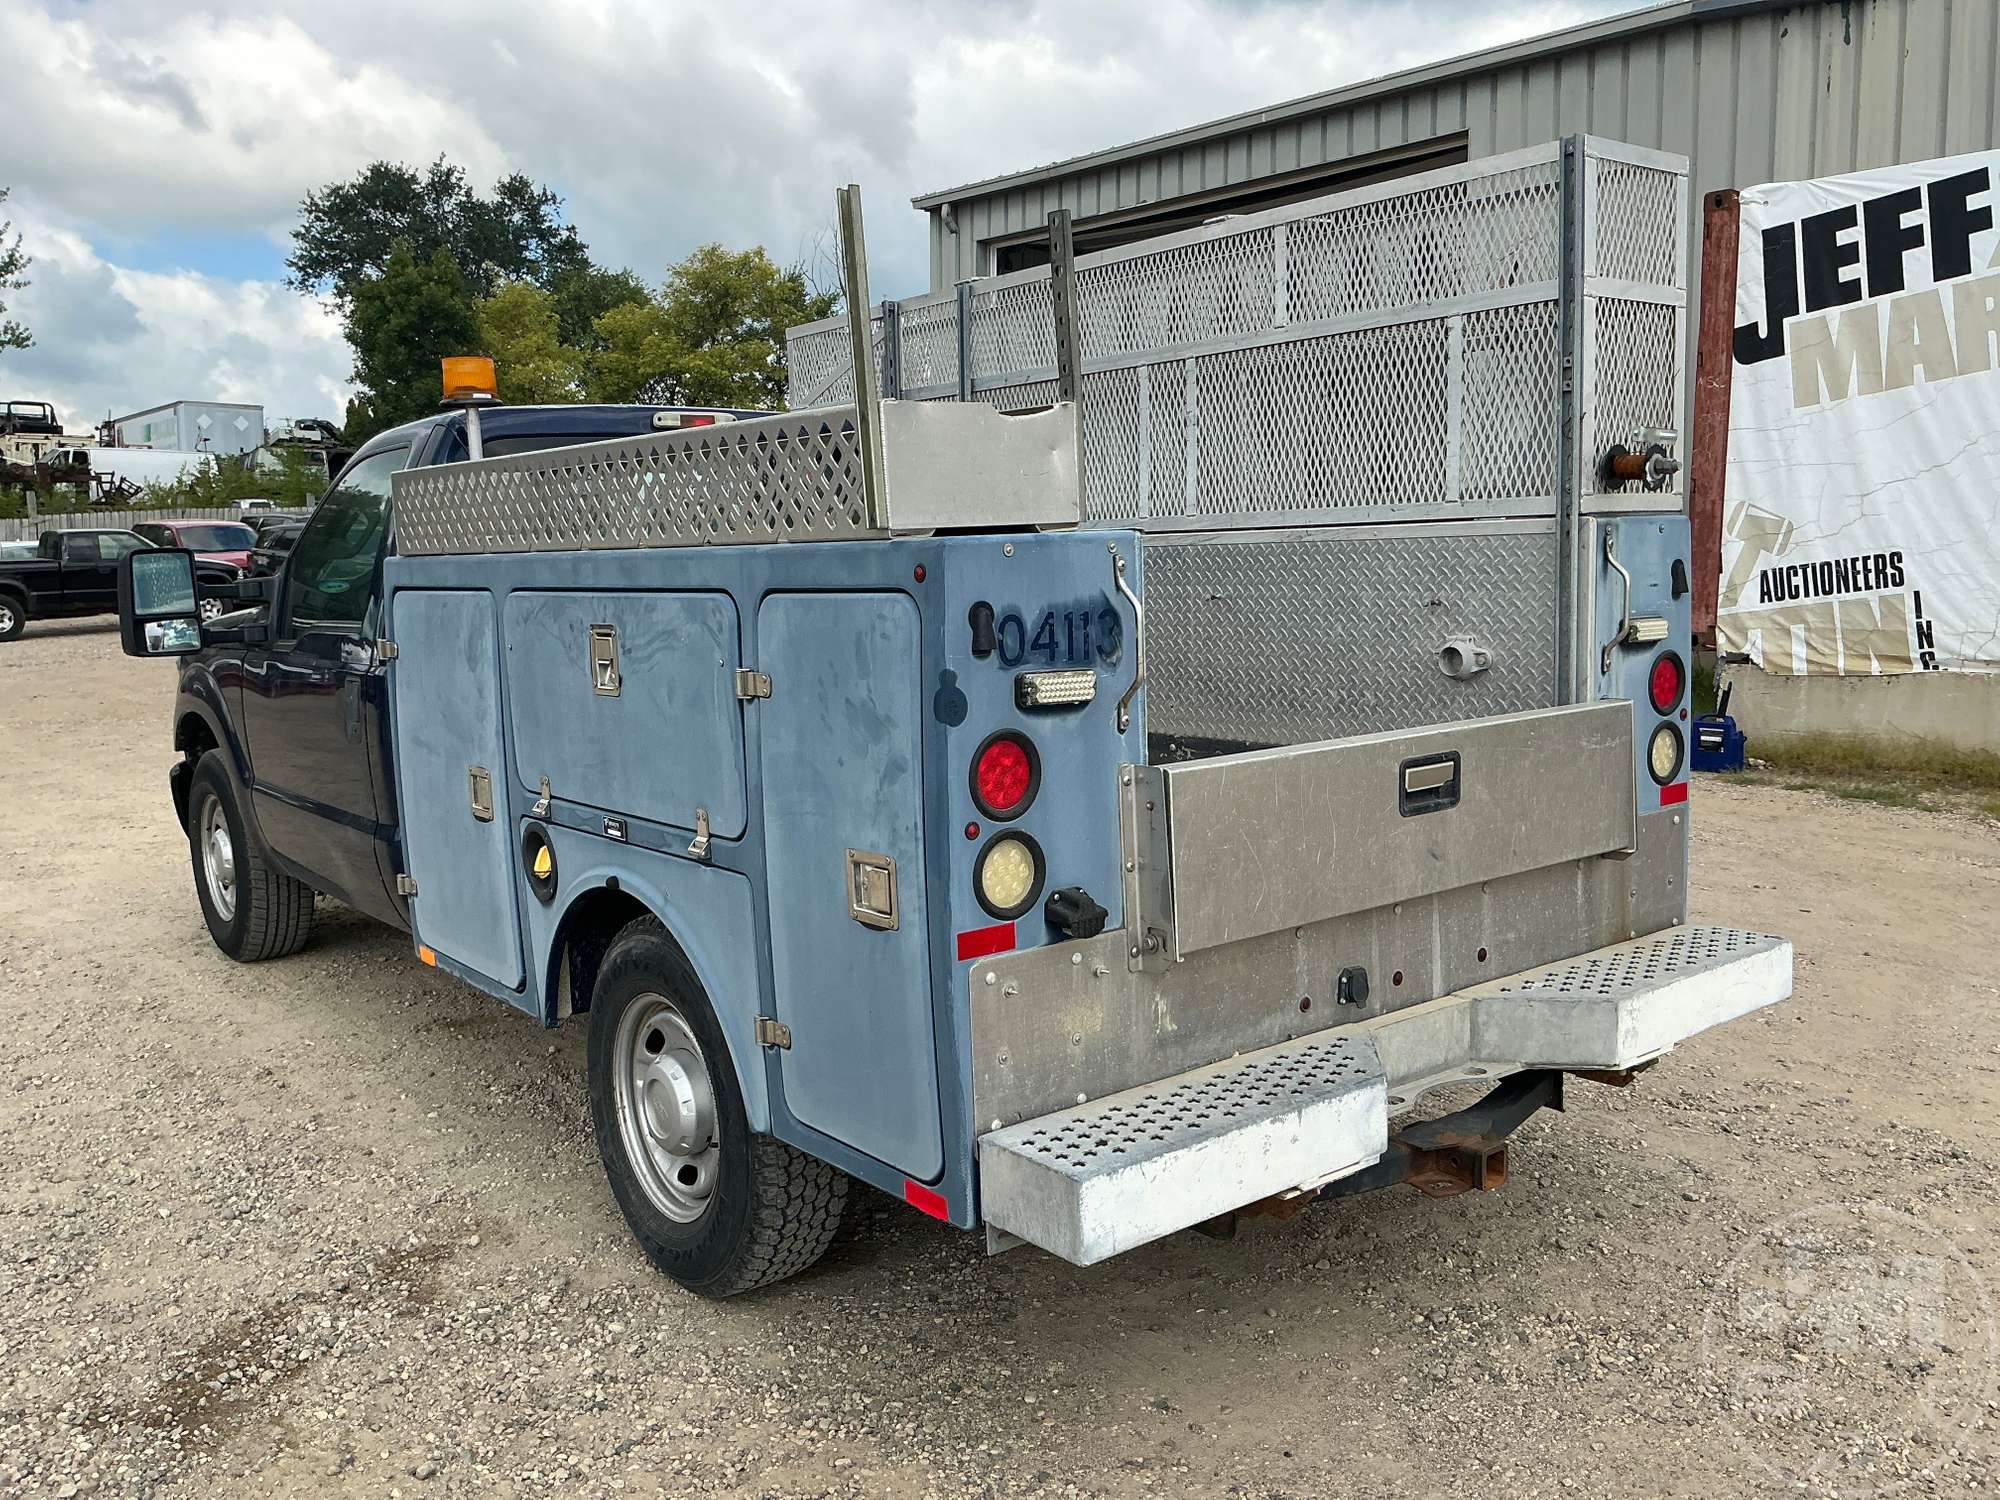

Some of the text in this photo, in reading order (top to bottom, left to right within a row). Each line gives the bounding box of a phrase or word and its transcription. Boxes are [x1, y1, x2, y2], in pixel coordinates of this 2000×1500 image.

[1733, 166, 1994, 365] JEFF
[1759, 551, 1905, 604] AUCTIONEERS
[998, 607, 1121, 667] 04113
